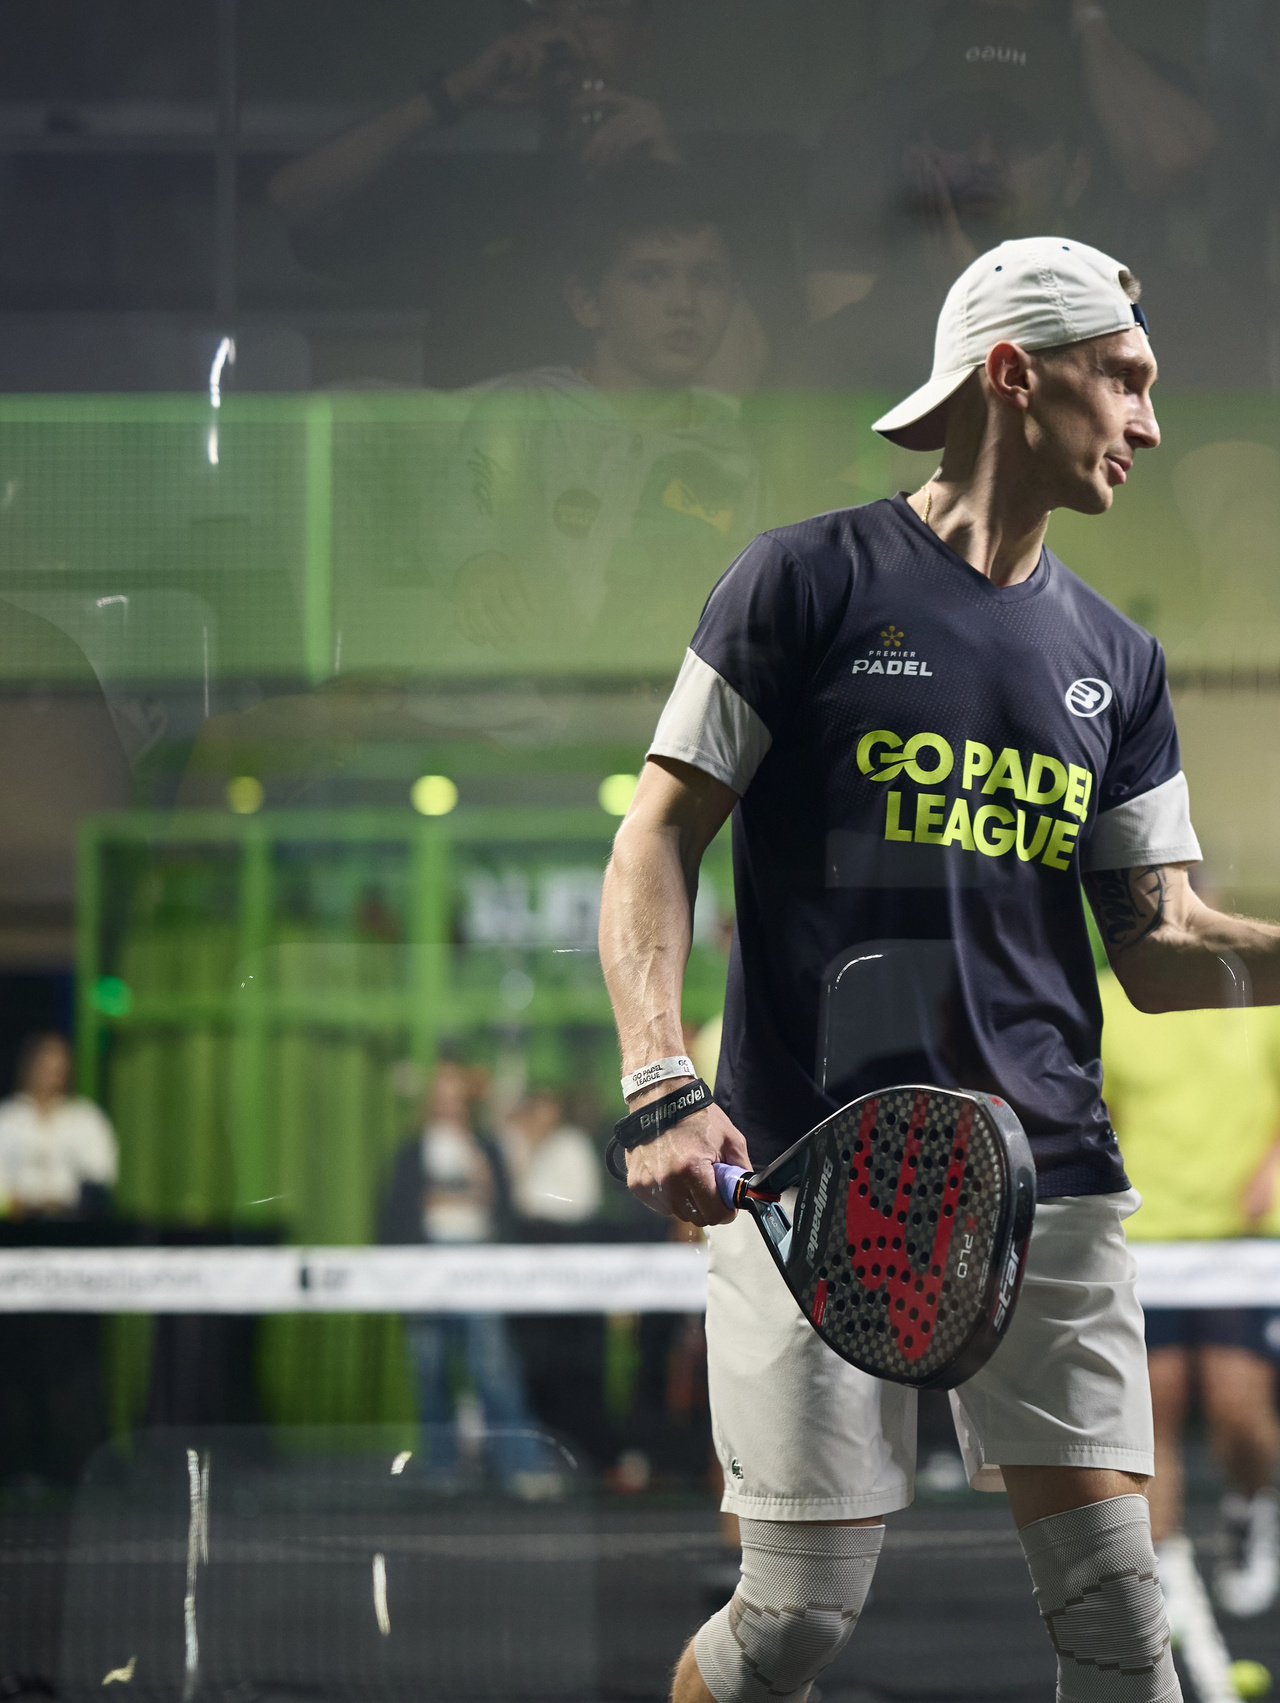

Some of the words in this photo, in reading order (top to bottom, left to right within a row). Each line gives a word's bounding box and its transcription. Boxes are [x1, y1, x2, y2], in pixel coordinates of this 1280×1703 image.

[852, 659, 933, 677] PADEL
[868, 650, 916, 658] PREMIER
[856, 729, 954, 785] GO
[884, 790, 1080, 871] LEAGUE
[632, 1072, 642, 1081] GO
[643, 1064, 662, 1076] PADEL
[636, 1072, 661, 1087] LEAGUE
[640, 1085, 705, 1130] Bullpadel
[804, 1155, 834, 1269] Bullpadel
